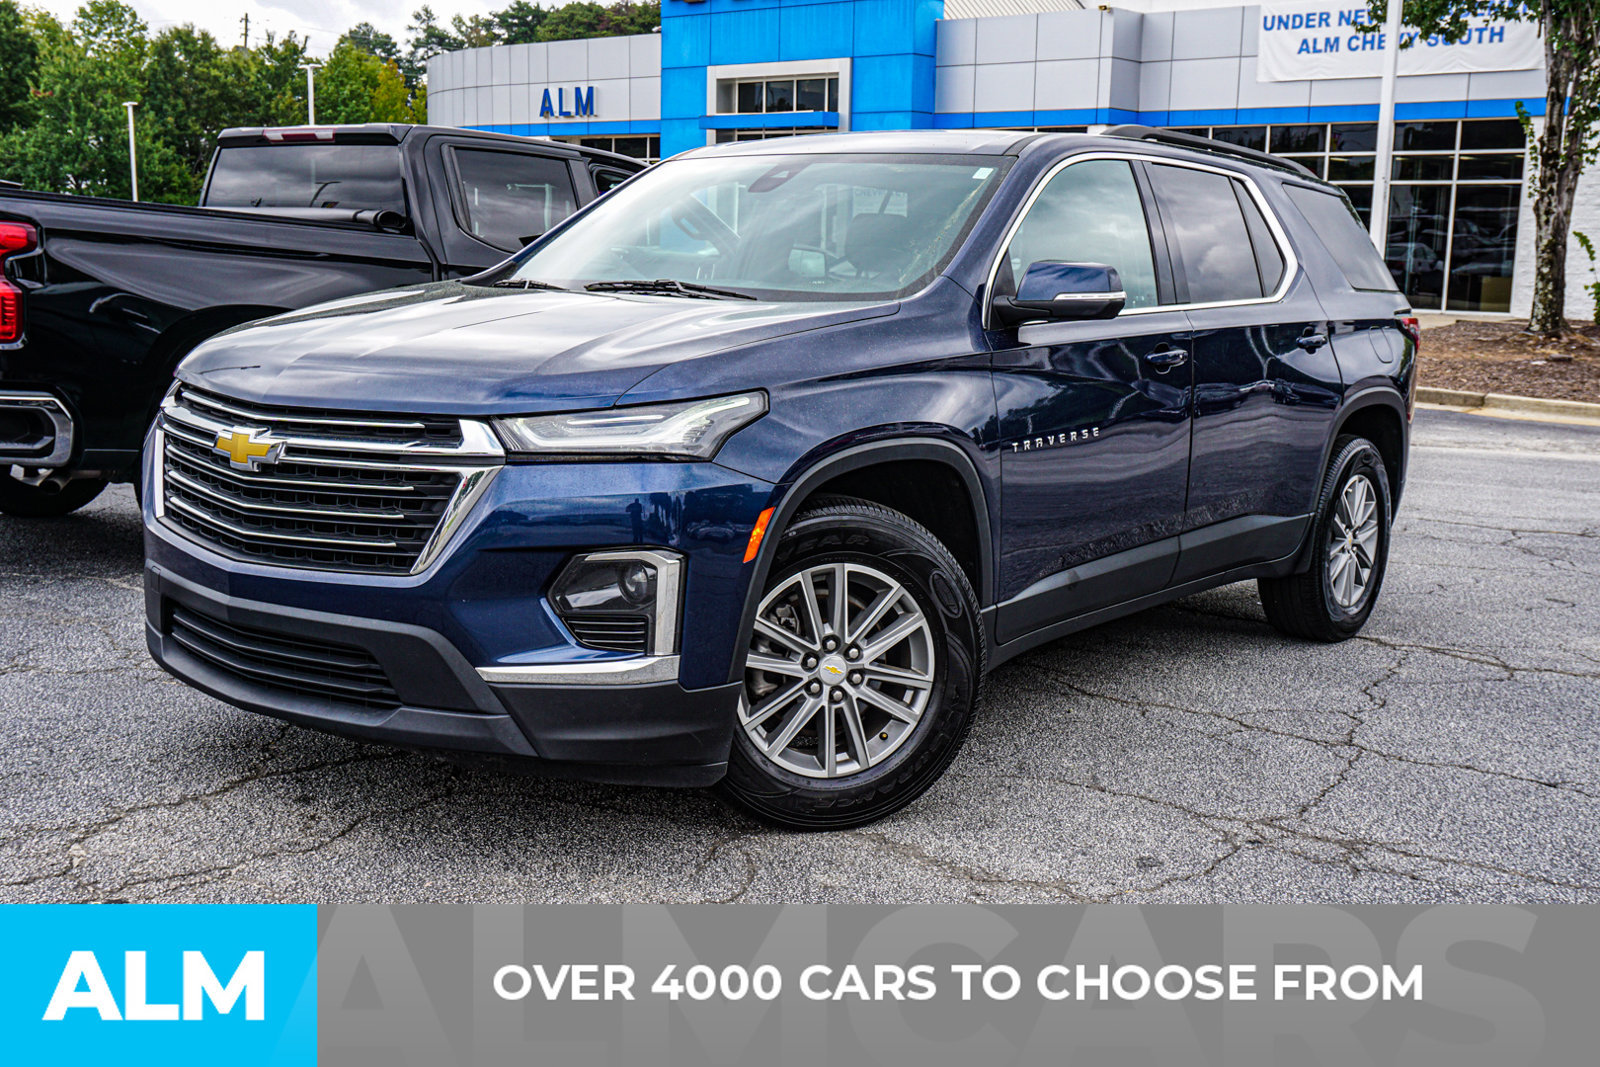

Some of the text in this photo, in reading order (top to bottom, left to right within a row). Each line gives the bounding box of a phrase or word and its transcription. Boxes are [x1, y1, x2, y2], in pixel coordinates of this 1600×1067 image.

[1263, 12, 1331, 31] UNDER
[1297, 36, 1340, 54] ALM
[539, 86, 595, 117] ALM
[1012, 427, 1099, 453] TRAVERSE
